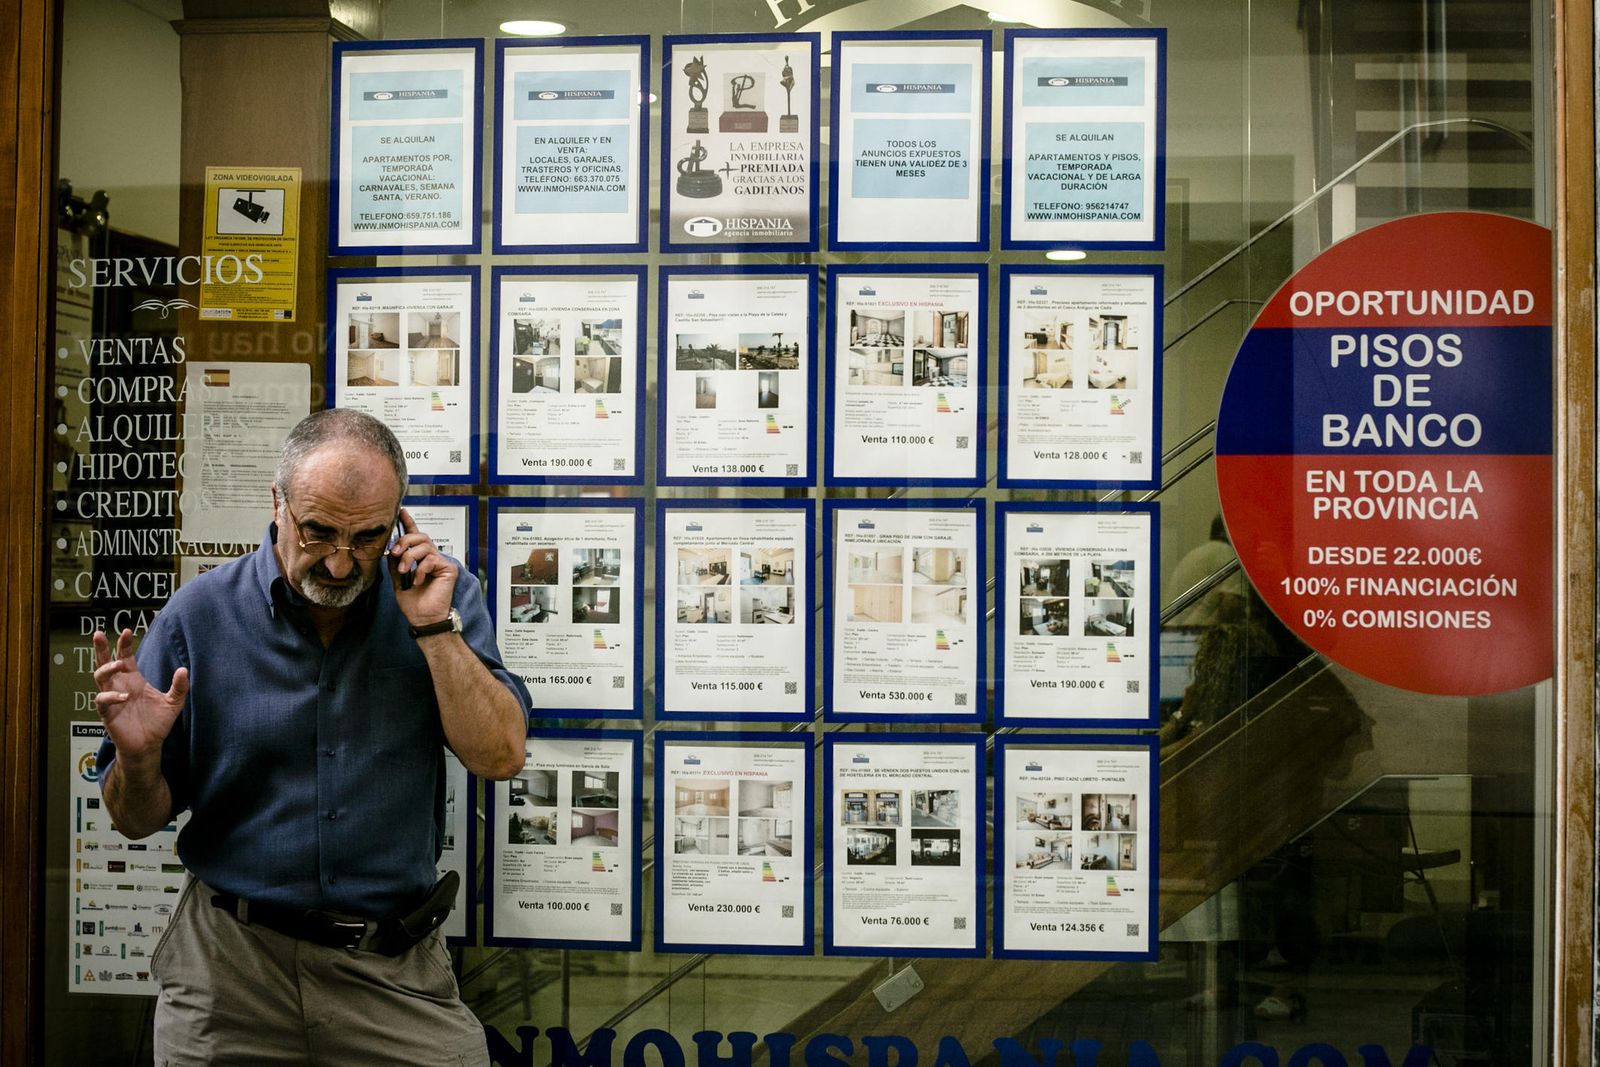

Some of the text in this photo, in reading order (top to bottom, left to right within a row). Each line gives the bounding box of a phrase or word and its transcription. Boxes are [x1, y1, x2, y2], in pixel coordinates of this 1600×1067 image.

[393, 136, 435, 144] ALQUILAN
[1070, 134, 1114, 142] ALQUILAN
[730, 142, 804, 151] LA EMPRESA
[363, 154, 452, 163] APARTAMENTOS POR,
[731, 153, 804, 161] INMOBILIARIA
[910, 150, 961, 158] EXPUESTOS
[1112, 154, 1141, 162] PISOS,
[573, 156, 615, 164] GARAJES,
[582, 165, 623, 173] OFICINAS.
[236, 174, 293, 182] VIDEOVIGILADA
[379, 174, 435, 182] VACACIONAL:
[359, 184, 418, 192] CARNAVALES,
[735, 186, 804, 195] GADITANOS
[373, 194, 402, 202] SANTA,
[353, 221, 460, 230] WWW.INMOHISPANIA.COM
[725, 218, 792, 229] HISPANIA
[69, 254, 263, 288] SERVICIOS
[1289, 289, 1534, 316] OPORTUNIDAD
[79, 337, 185, 365] VENTAS
[1331, 333, 1463, 368] PISOS
[78, 375, 212, 404] COMPRAS
[1373, 374, 1431, 407] DE
[1322, 413, 1482, 447] BANCO
[862, 435, 887, 443] Venta
[892, 436, 925, 444] 110.000
[424, 451, 429, 459] €
[1034, 451, 1060, 459] Venta
[1102, 452, 1108, 460] €
[1306, 470, 1483, 493] EN TODA LA
[1313, 497, 1479, 520] PROVINCIA
[1308, 547, 1482, 565] DESDE 22.000€
[1280, 575, 1517, 596] 100% FINANCIACIÓN
[81, 609, 160, 636] DE CA
[1303, 609, 1491, 629] 0% COMISIONES
[550, 676, 583, 684] 165.000
[586, 676, 591, 684] €
[1031, 680, 1056, 688] Venta
[1060, 680, 1096, 688] 190.000
[692, 682, 763, 690] Venta 115.000 €
[860, 691, 885, 699] Venta
[889, 692, 924, 700] 530.000
[519, 901, 590, 911] Venta 100.000 €
[688, 904, 714, 912] Venta
[717, 905, 752, 913] 230.000
[862, 917, 929, 925] Venta 76.000 €
[1030, 923, 1104, 932] Venta 124.356 €
